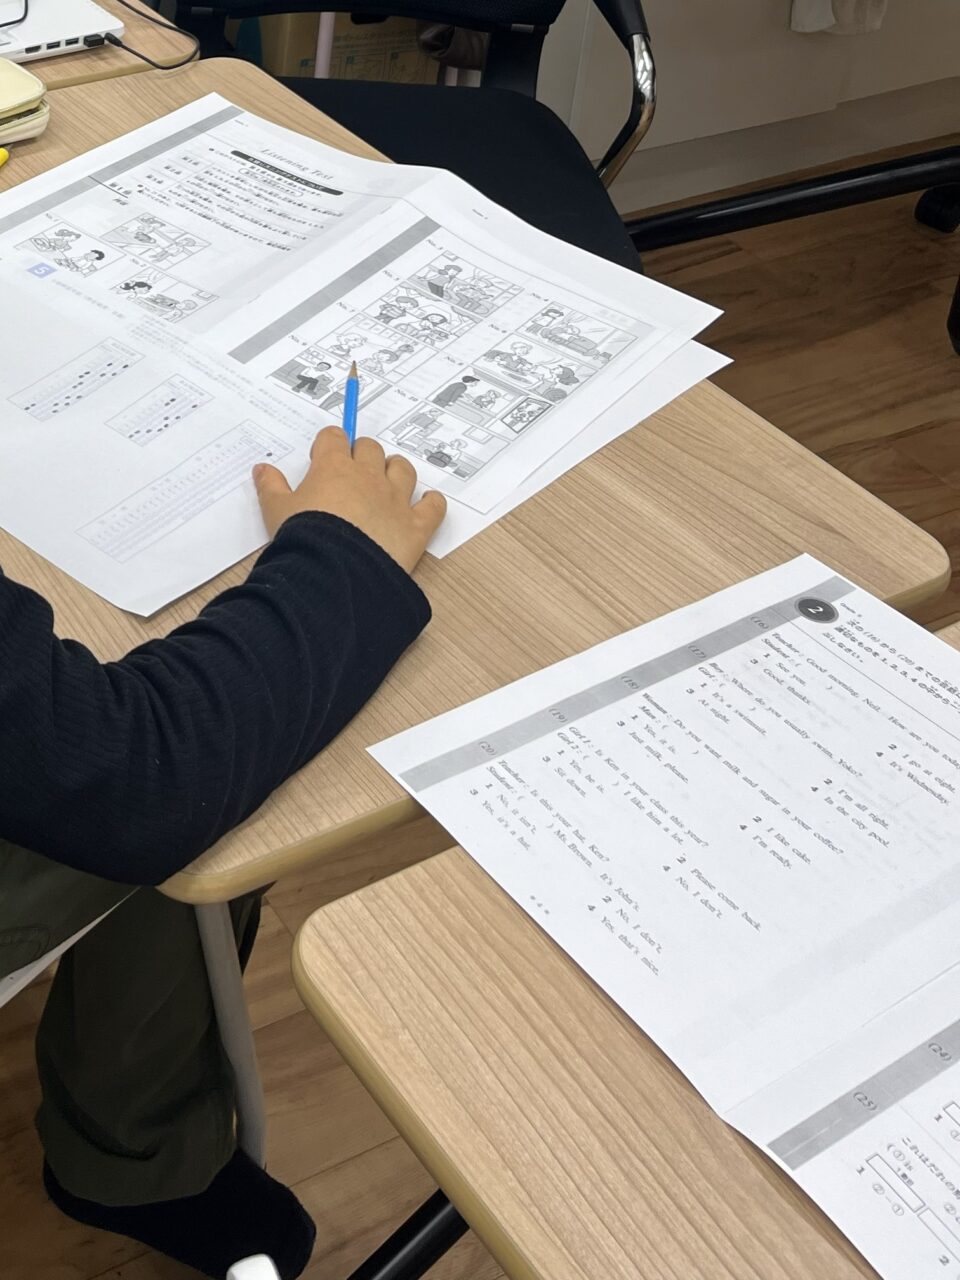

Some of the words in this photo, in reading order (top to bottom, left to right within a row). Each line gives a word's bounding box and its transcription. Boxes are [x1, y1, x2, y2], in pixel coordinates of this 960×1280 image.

[260, 149, 308, 171] Listening
[311, 169, 333, 179] Test
[750, 616, 769, 629] (16)
[687, 645, 706, 658] (17)
[620, 675, 640, 689] (18)
[548, 708, 567, 722] (19)
[478, 741, 497, 755] (20)
[928, 1042, 951, 1060] (24)
[853, 1091, 877, 1110] (25)
